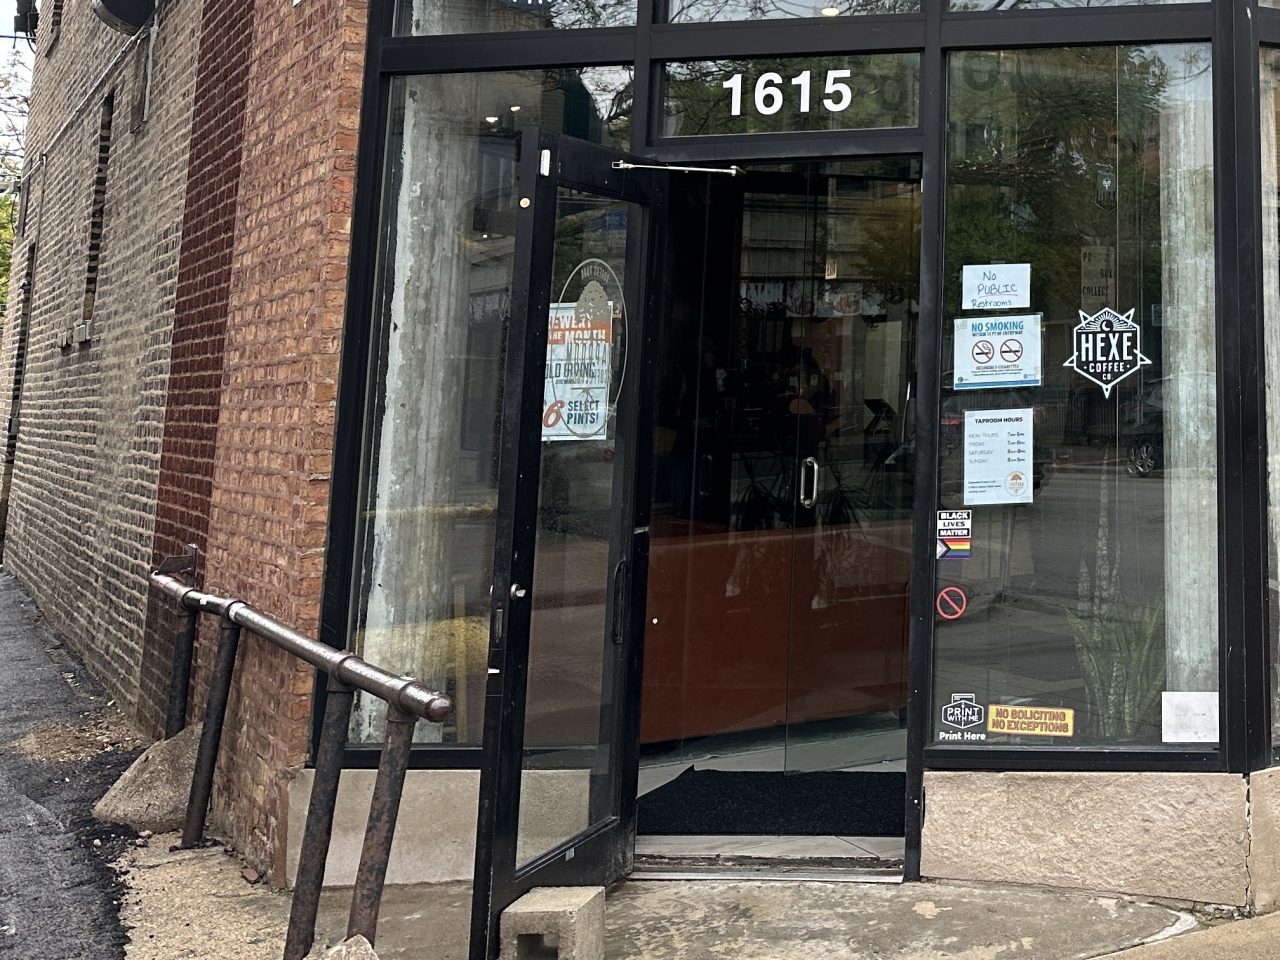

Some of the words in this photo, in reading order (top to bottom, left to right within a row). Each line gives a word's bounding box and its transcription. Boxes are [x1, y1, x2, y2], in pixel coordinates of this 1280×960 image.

[723, 69, 853, 117] 1615
[983, 271, 996, 280] No
[978, 283, 1018, 295] PUBLIC
[971, 299, 1012, 308] Restrooms
[971, 323, 983, 332] NO
[986, 321, 1024, 331] SMOKING
[1081, 332, 1133, 361] HEXE
[1089, 362, 1125, 373] COFFEE
[568, 400, 600, 411] SELECT
[566, 412, 598, 424] PINTS!
[940, 512, 968, 520] BLACK
[947, 705, 979, 716] PRINT
[995, 708, 1009, 719] NO
[1010, 710, 1066, 722] SOLICITING
[992, 719, 1006, 730] NO
[1007, 720, 1069, 733] EXCEPTIONS
[939, 730, 961, 740] Print
[964, 731, 986, 740] Here
